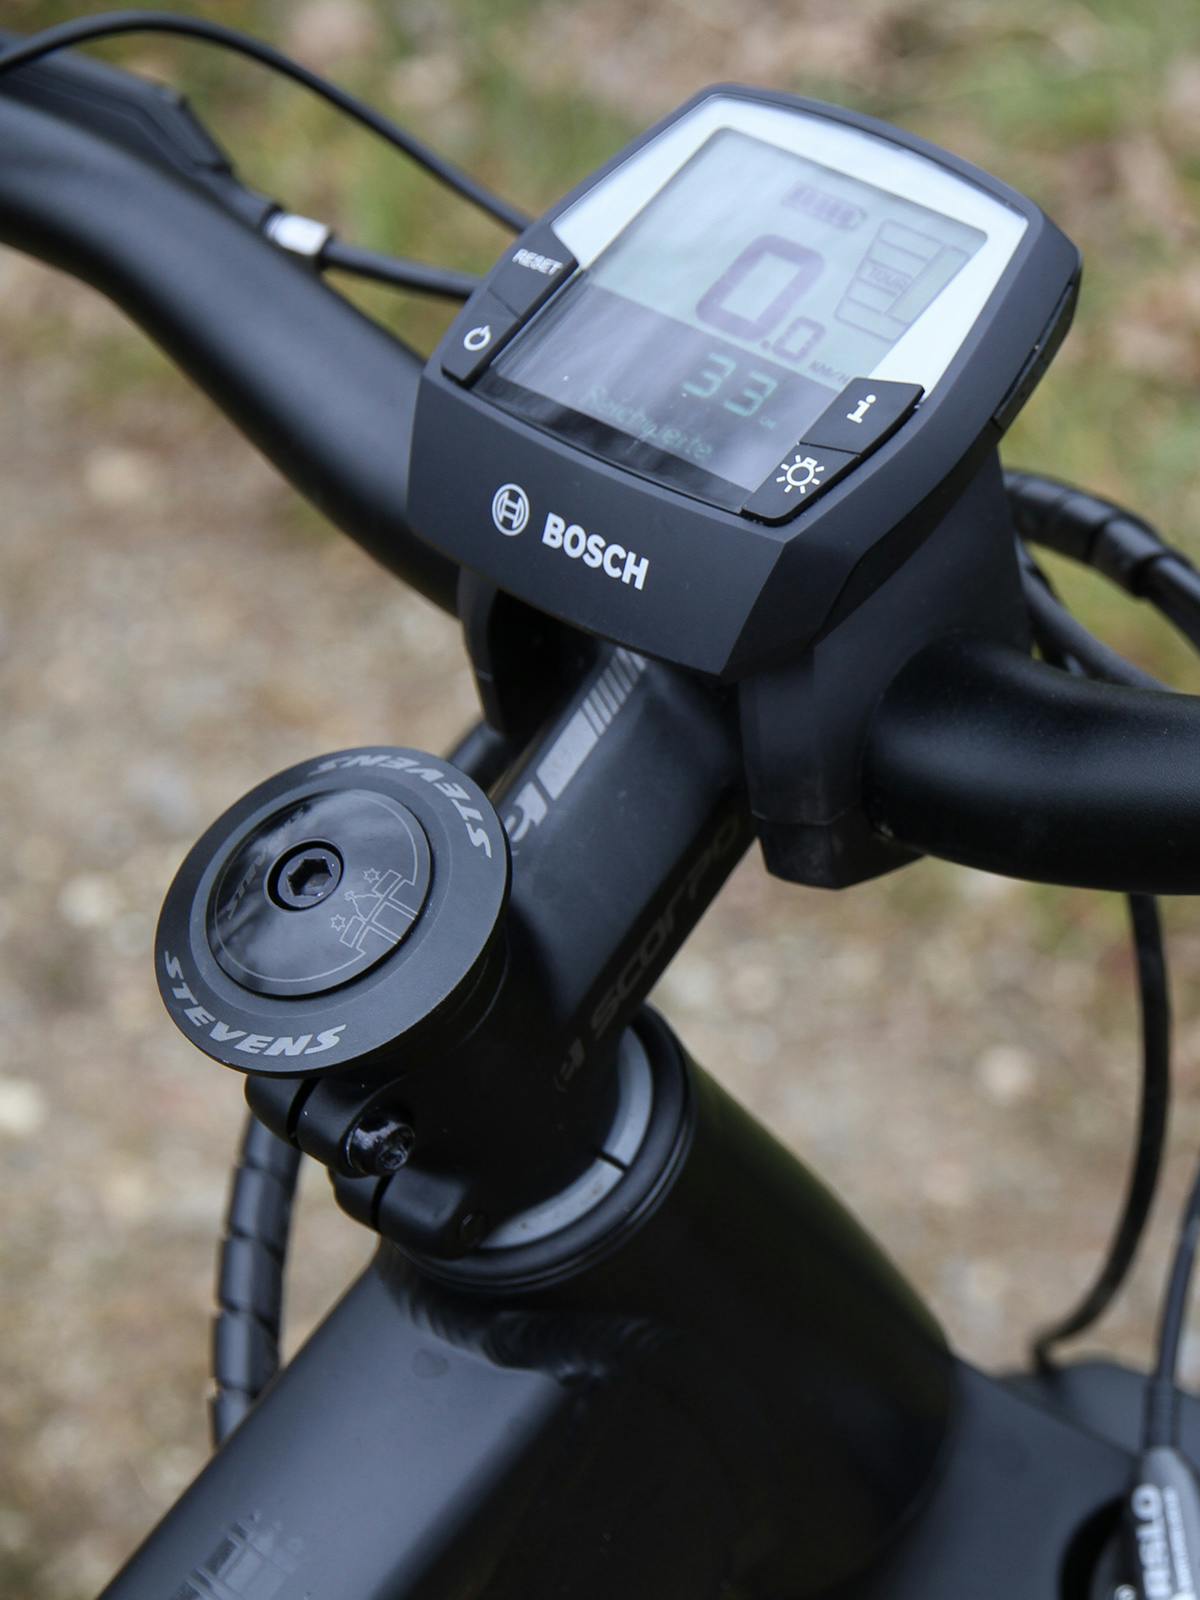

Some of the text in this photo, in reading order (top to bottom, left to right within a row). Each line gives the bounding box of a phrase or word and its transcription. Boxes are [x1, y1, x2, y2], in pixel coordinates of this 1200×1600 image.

[511, 248, 563, 276] RESET
[682, 353, 778, 416] 33
[542, 512, 650, 590] BOSCH
[307, 754, 492, 858] STEVENS
[164, 951, 346, 1056] STEVENS
